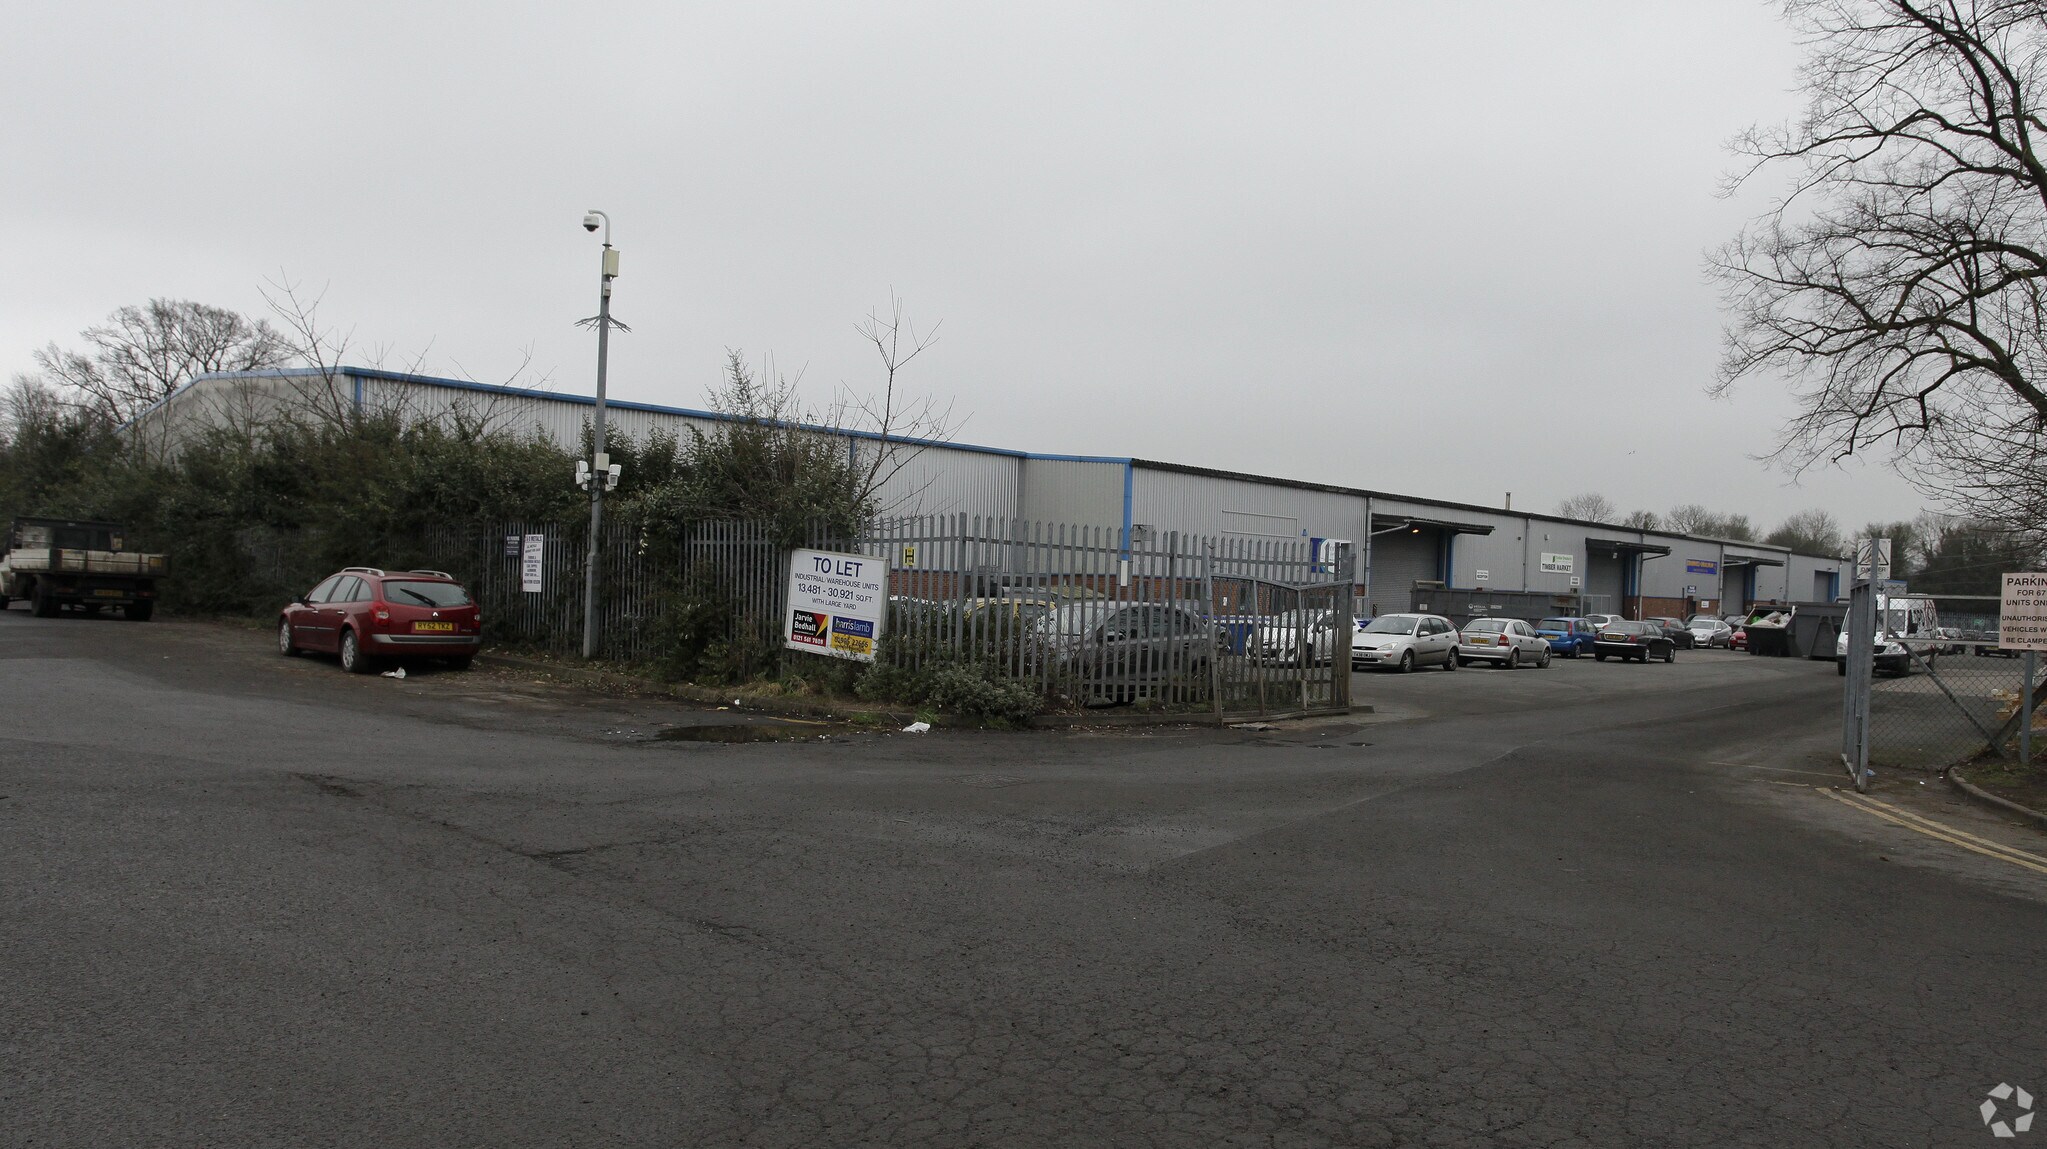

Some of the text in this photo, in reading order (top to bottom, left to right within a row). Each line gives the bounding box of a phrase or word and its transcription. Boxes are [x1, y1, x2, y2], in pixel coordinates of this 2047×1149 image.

[904, 548, 915, 564] H
[813, 557, 863, 578] TO LET
[1542, 563, 1571, 572] TIMBER MARKET
[798, 583, 821, 595] 13,481
[827, 588, 854, 600] 30,921
[825, 599, 841, 608] LARGE
[795, 613, 813, 622] Jarvie
[794, 621, 816, 632] Bedhall
